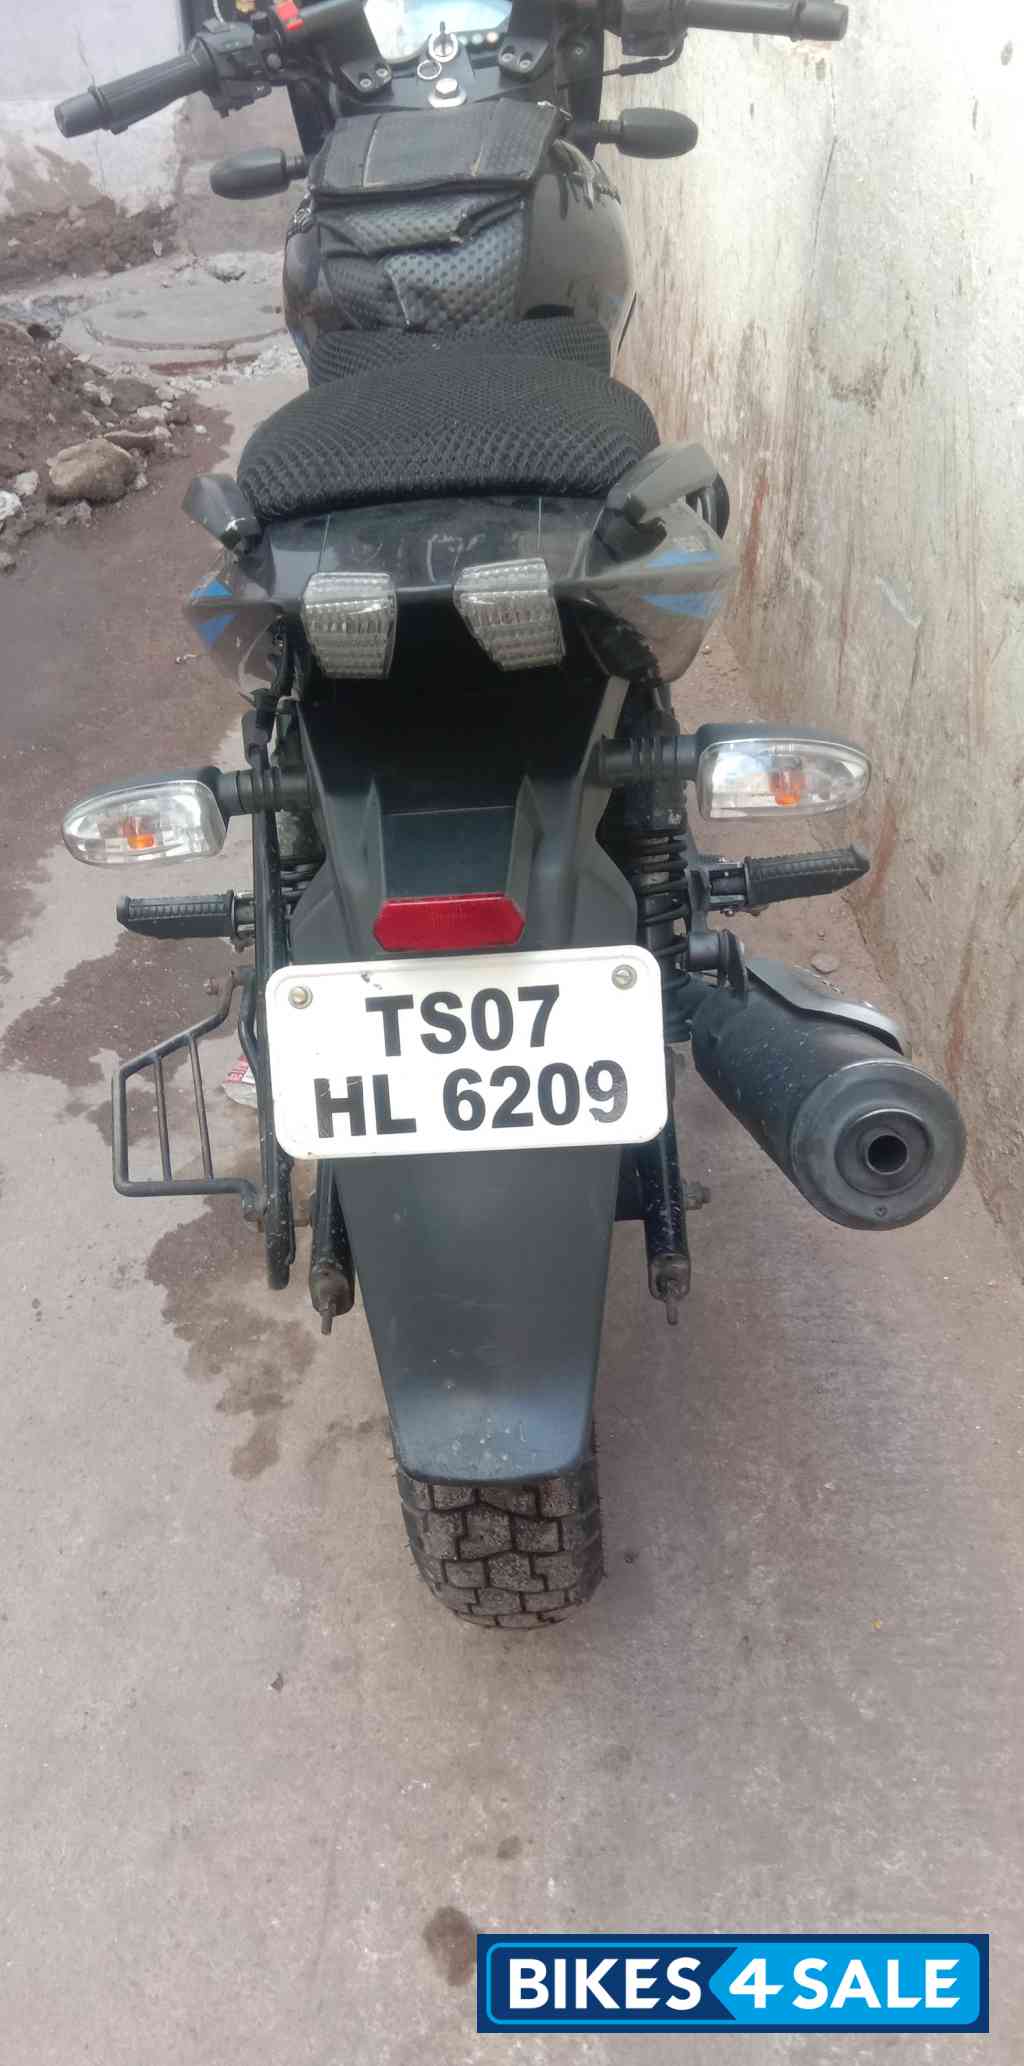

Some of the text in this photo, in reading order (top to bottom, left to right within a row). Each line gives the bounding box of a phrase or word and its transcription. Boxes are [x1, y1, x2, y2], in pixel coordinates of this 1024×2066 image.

[365, 984, 561, 1057] TS07
[314, 1060, 628, 1138] HL 6209
